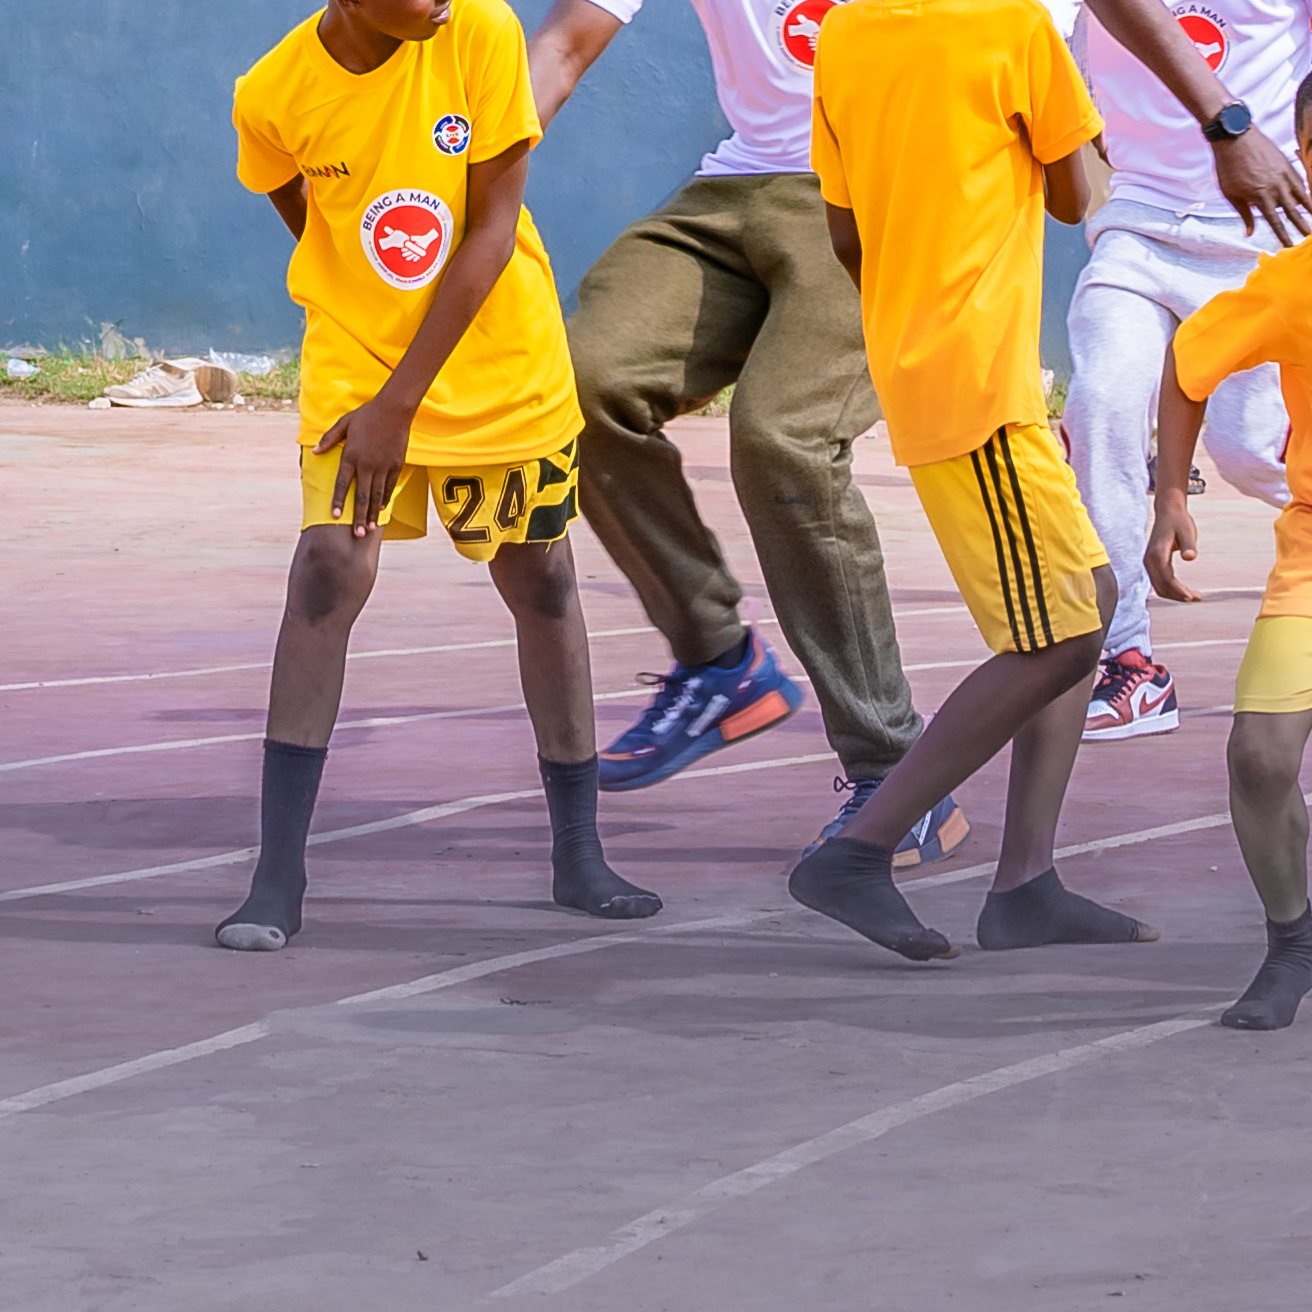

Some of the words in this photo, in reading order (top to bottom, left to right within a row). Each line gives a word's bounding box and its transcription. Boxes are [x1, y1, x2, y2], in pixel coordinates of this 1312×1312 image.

[1188, 4, 1197, 13] A
[1200, 6, 1227, 29] MAN
[362, 196, 392, 231] BEING
[395, 192, 405, 203] A
[409, 192, 440, 211] MAN
[442, 466, 528, 545] 24
